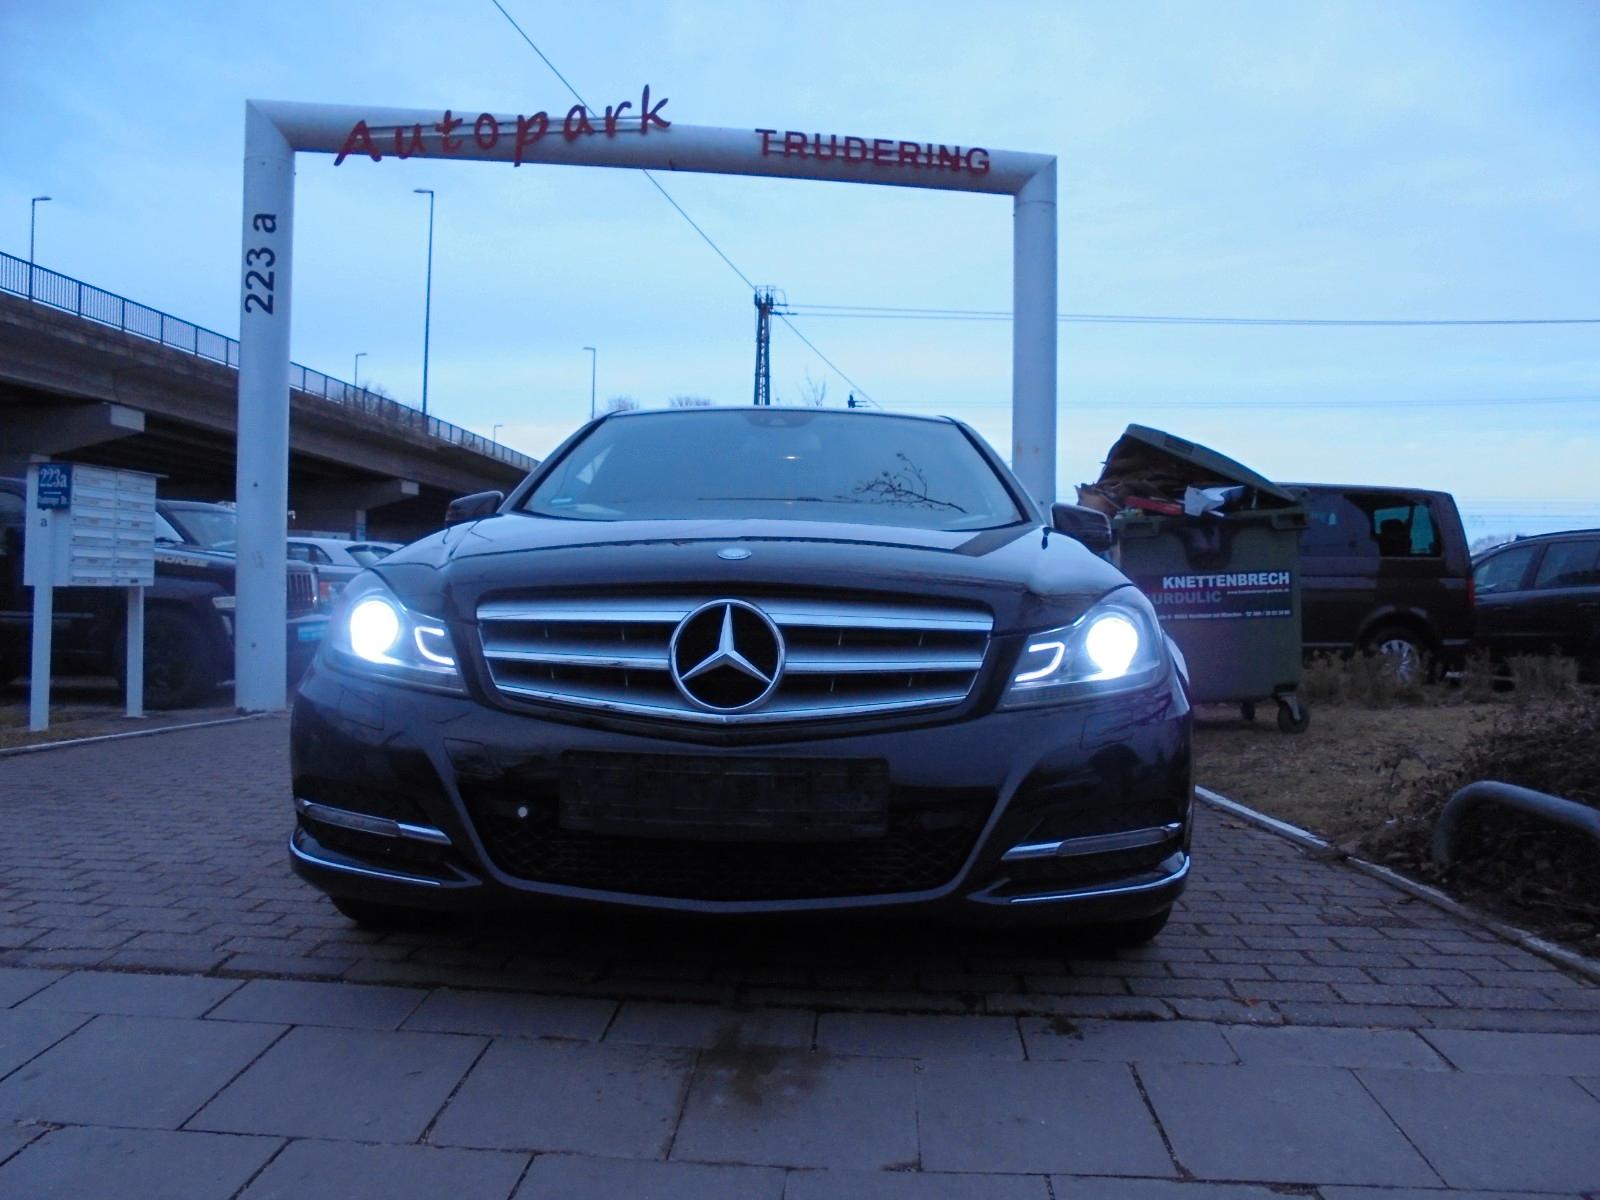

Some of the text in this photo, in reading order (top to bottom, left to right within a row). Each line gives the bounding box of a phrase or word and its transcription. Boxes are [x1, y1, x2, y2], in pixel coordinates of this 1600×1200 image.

[333, 84, 672, 167] Autopark
[755, 128, 990, 175] TRUDERING
[244, 213, 277, 315] 223 a
[39, 468, 68, 488] 223a
[1162, 572, 1290, 589] KNETTENBRECH
